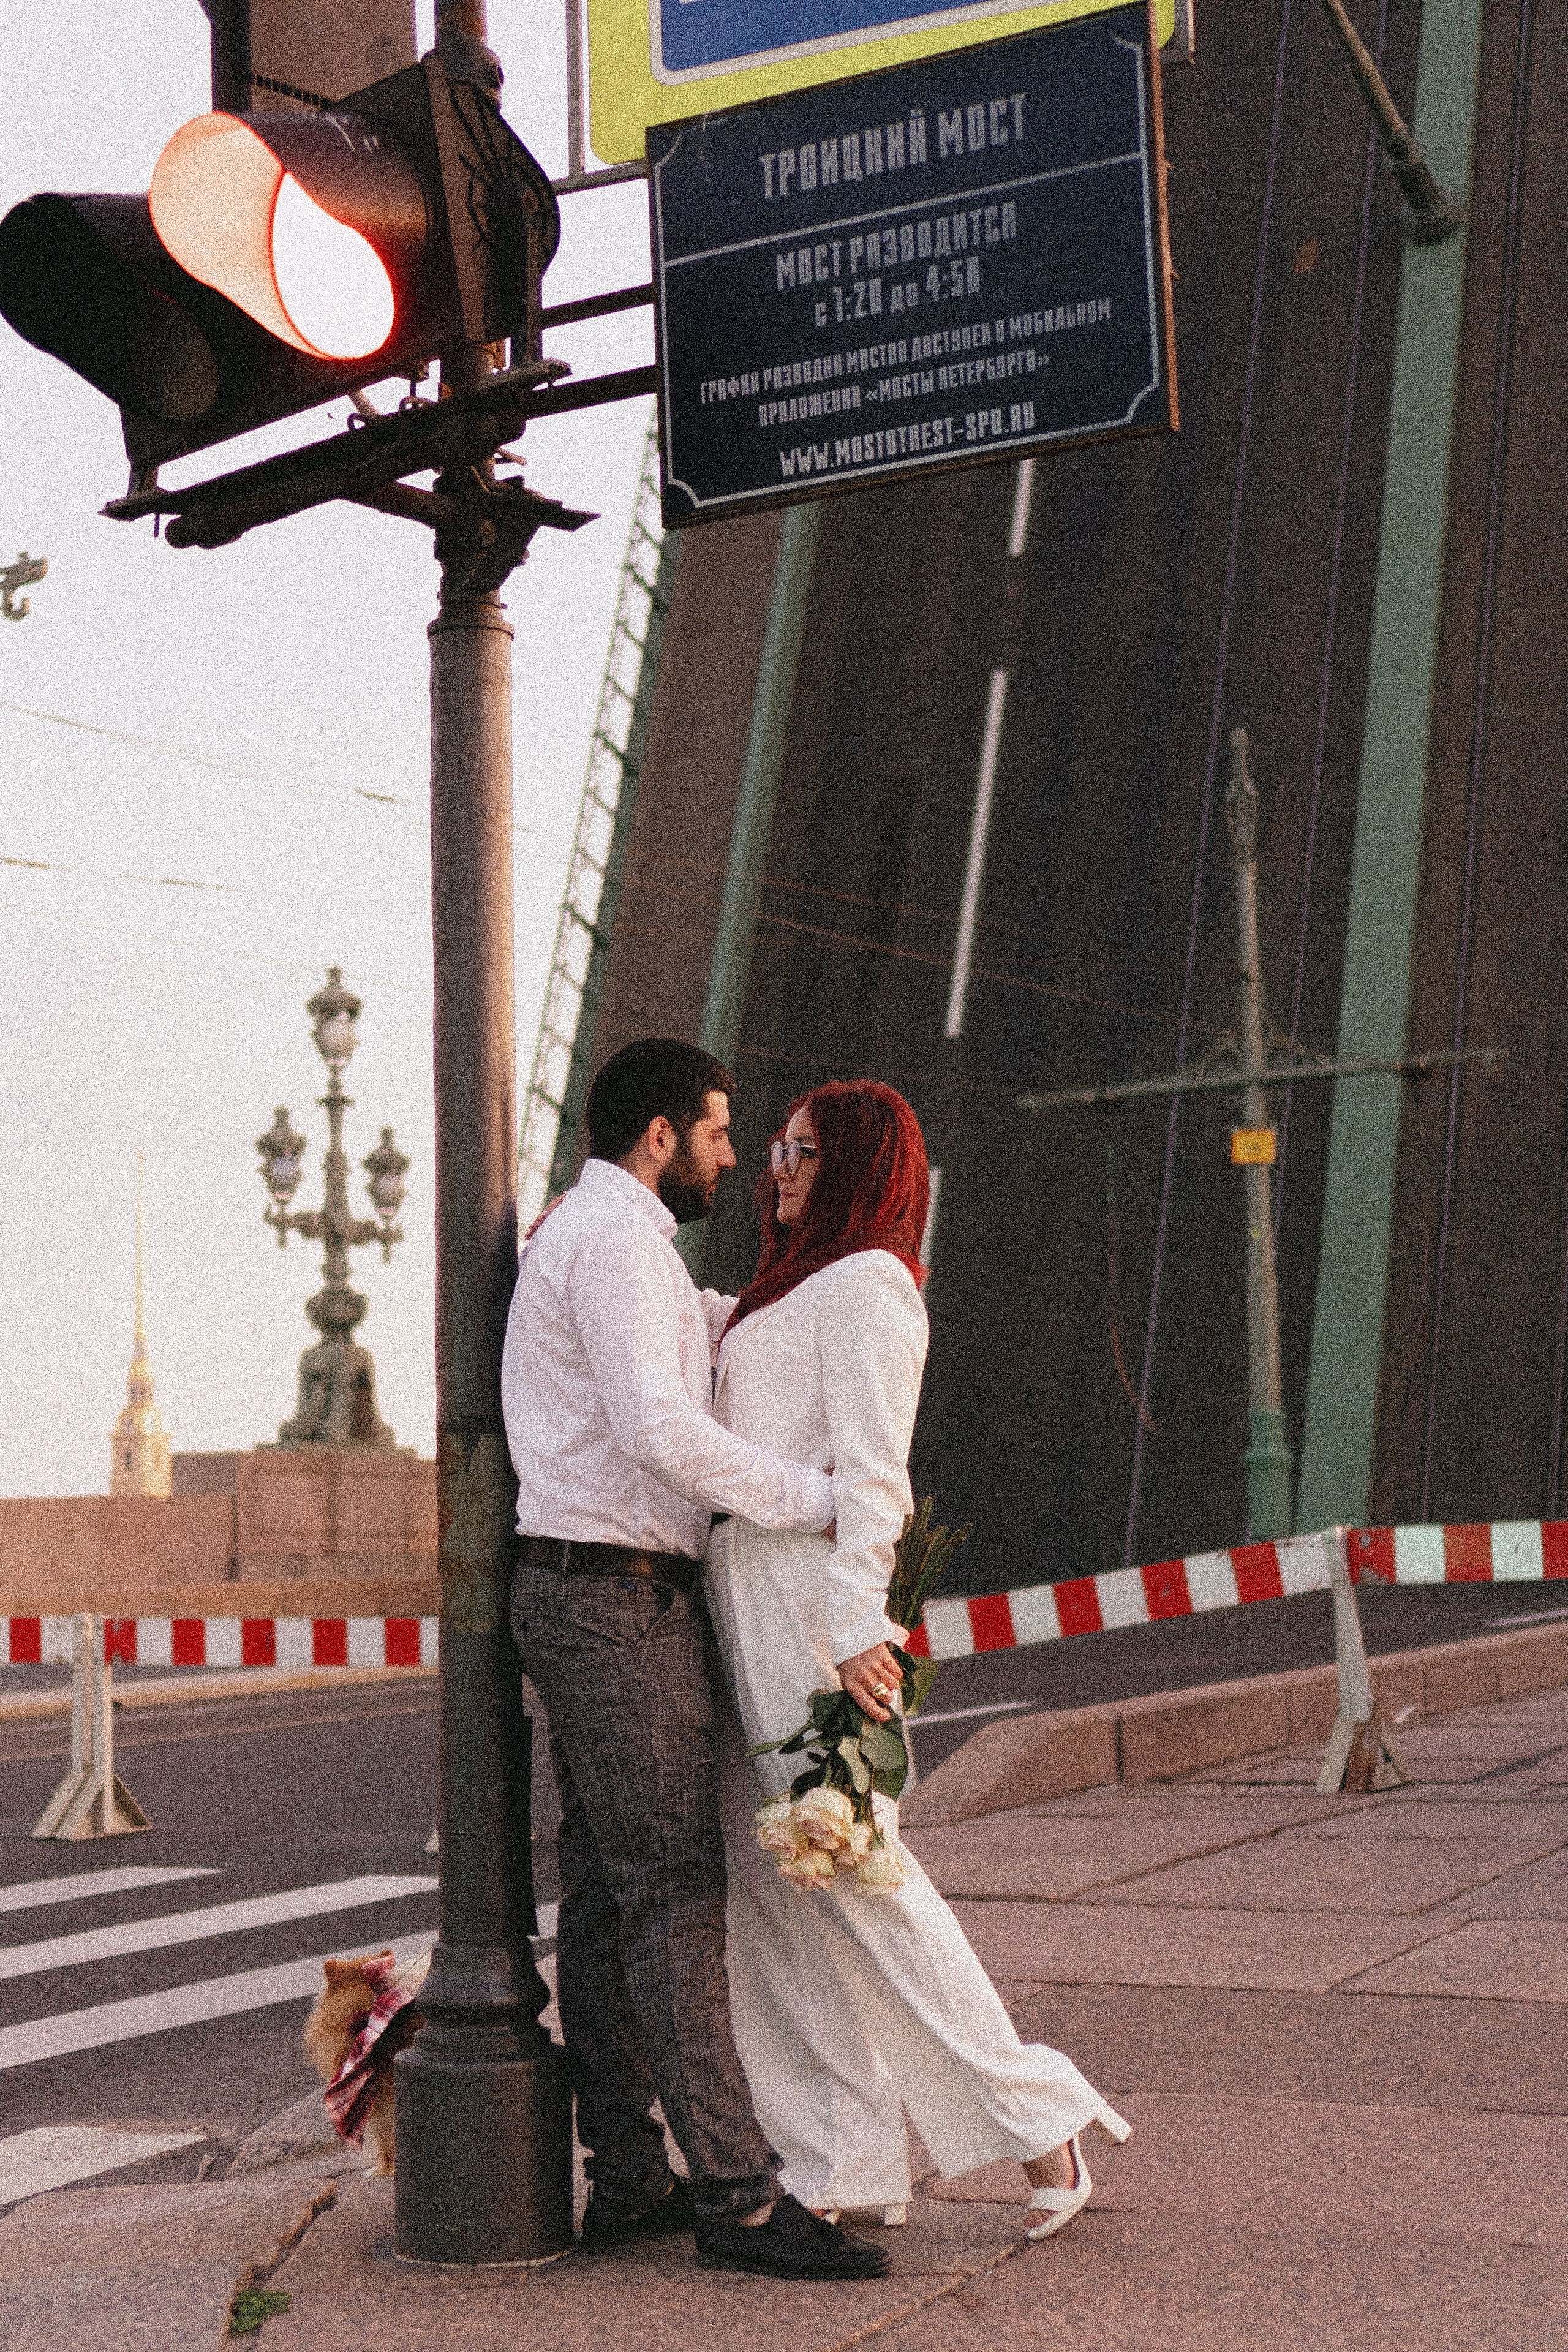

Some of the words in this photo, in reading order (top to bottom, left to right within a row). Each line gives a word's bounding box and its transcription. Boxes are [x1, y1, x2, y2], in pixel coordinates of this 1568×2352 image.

[760, 108, 927, 199] ТРОИЦКИЙ
[937, 93, 1027, 159] МОСТ
[775, 241, 842, 290] МОСТ
[849, 200, 1017, 274] РАЗВОДИТСЯ
[832, 277, 883, 323] 1:20
[925, 255, 981, 303] 4:50
[700, 371, 760, 404] ГРАФИК
[763, 353, 843, 391] РАЗВОДКИ
[846, 339, 907, 374] МОСТОВ
[911, 322, 991, 363] ДОСТУПЕН
[995, 319, 1006, 342] В
[1009, 296, 1112, 340] МОБИЛЬНОМ
[758, 385, 862, 428] ПРИЛОЖЕНИИ
[865, 369, 934, 403] «МОСТЫ
[938, 349, 1051, 390] ПЕТЕРБУРГА»
[779, 401, 1036, 477] WWW.MOSTOTREST-SPB.RU
